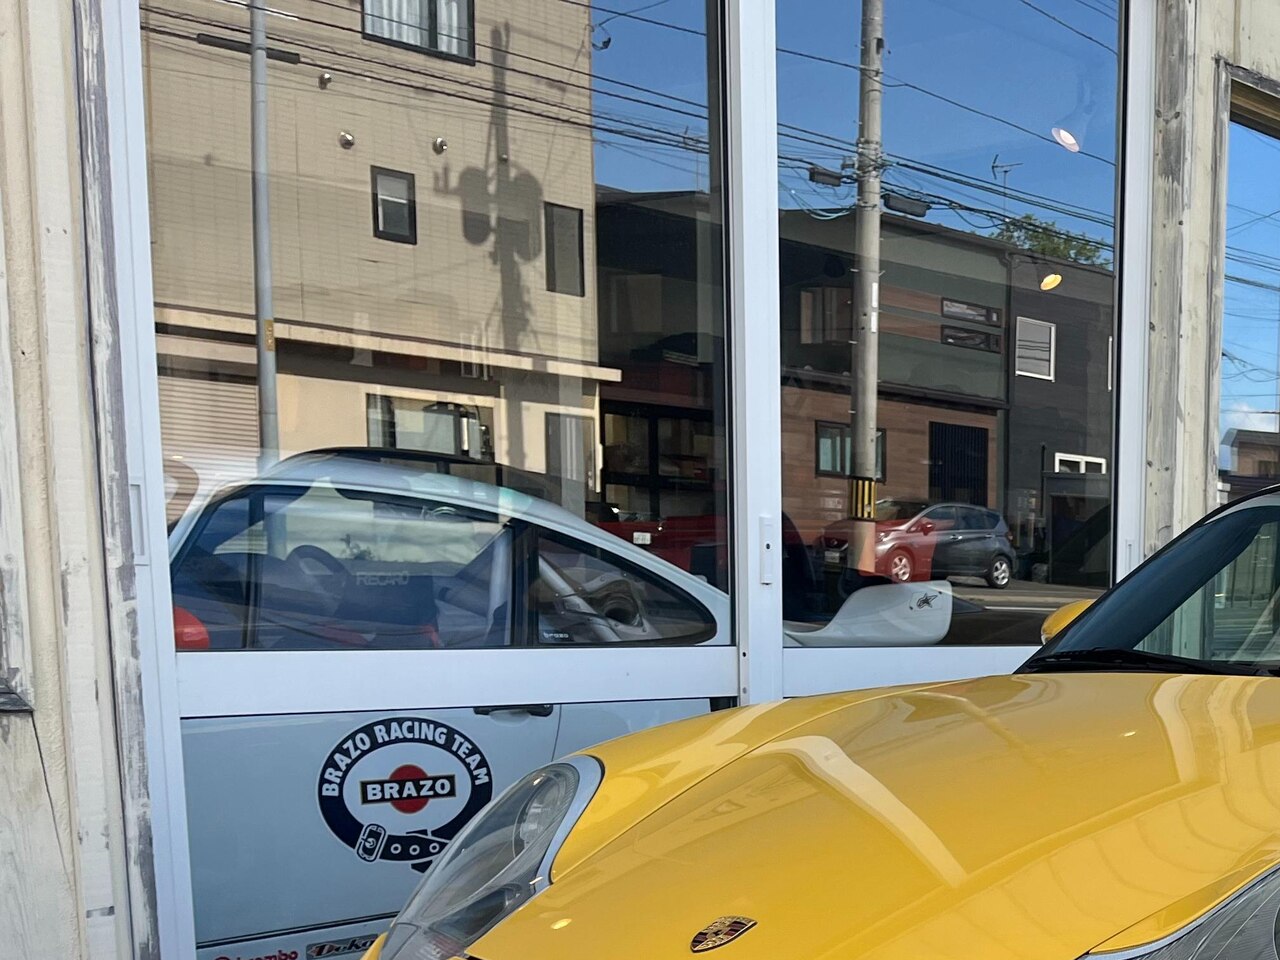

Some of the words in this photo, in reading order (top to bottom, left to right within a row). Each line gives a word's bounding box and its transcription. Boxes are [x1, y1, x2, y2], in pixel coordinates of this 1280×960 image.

[322, 732, 371, 797] BRAZO
[373, 721, 447, 744] RACING
[451, 734, 489, 785] TEAM
[366, 779, 451, 801] BRAZO
